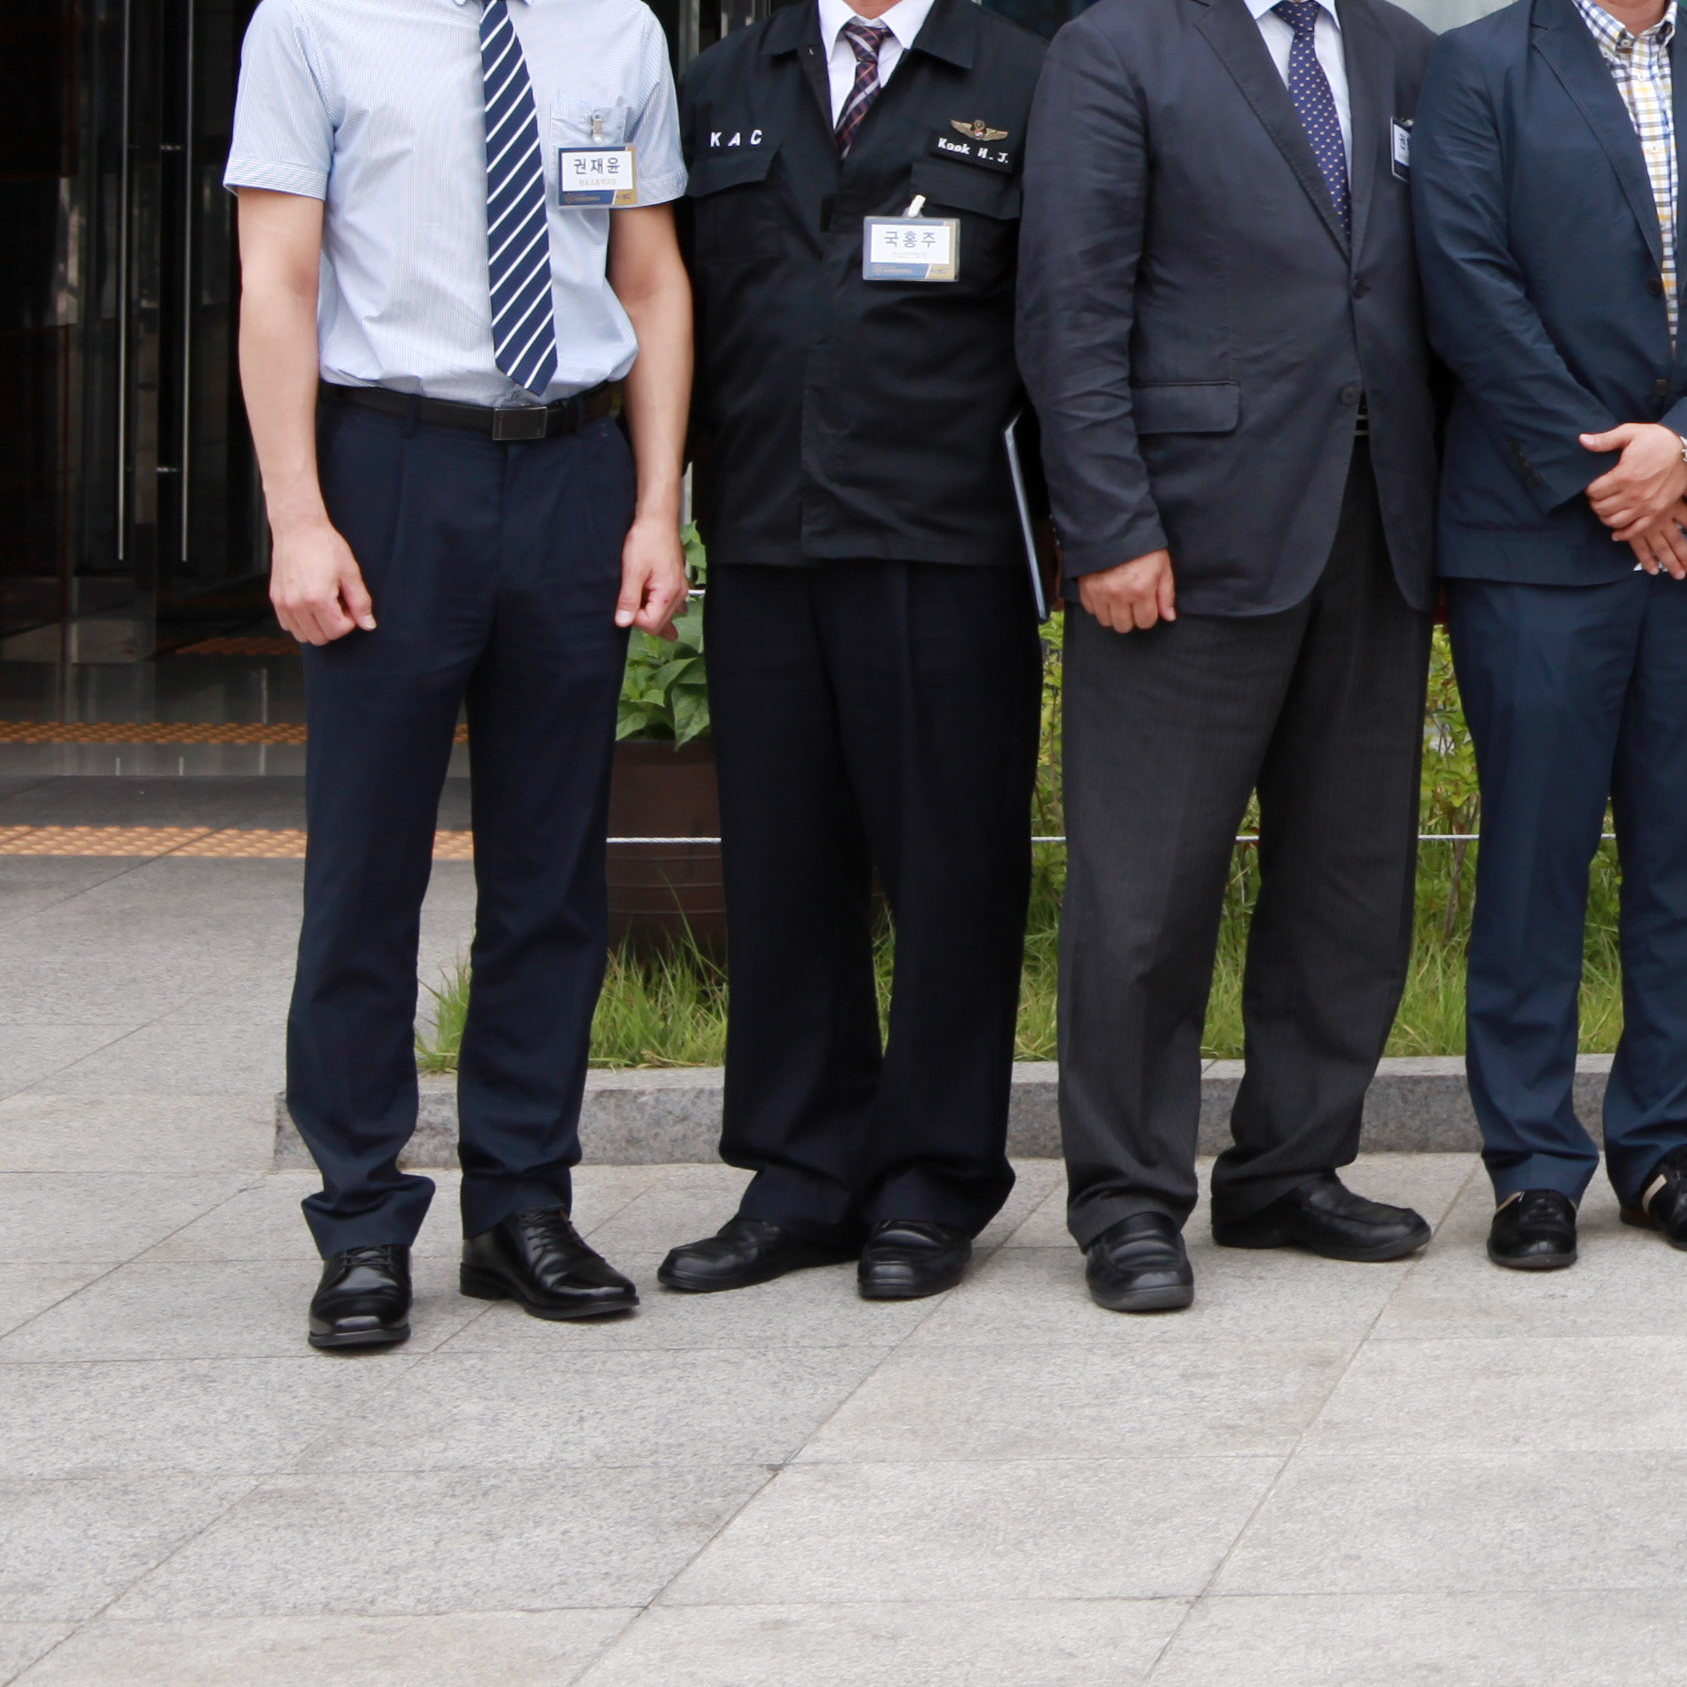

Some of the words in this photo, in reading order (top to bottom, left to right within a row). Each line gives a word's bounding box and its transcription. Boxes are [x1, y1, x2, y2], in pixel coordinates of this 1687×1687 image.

[937, 137, 971, 155] Kook
[573, 157, 620, 175] 권재윤
[883, 230, 937, 249] 국홍주
